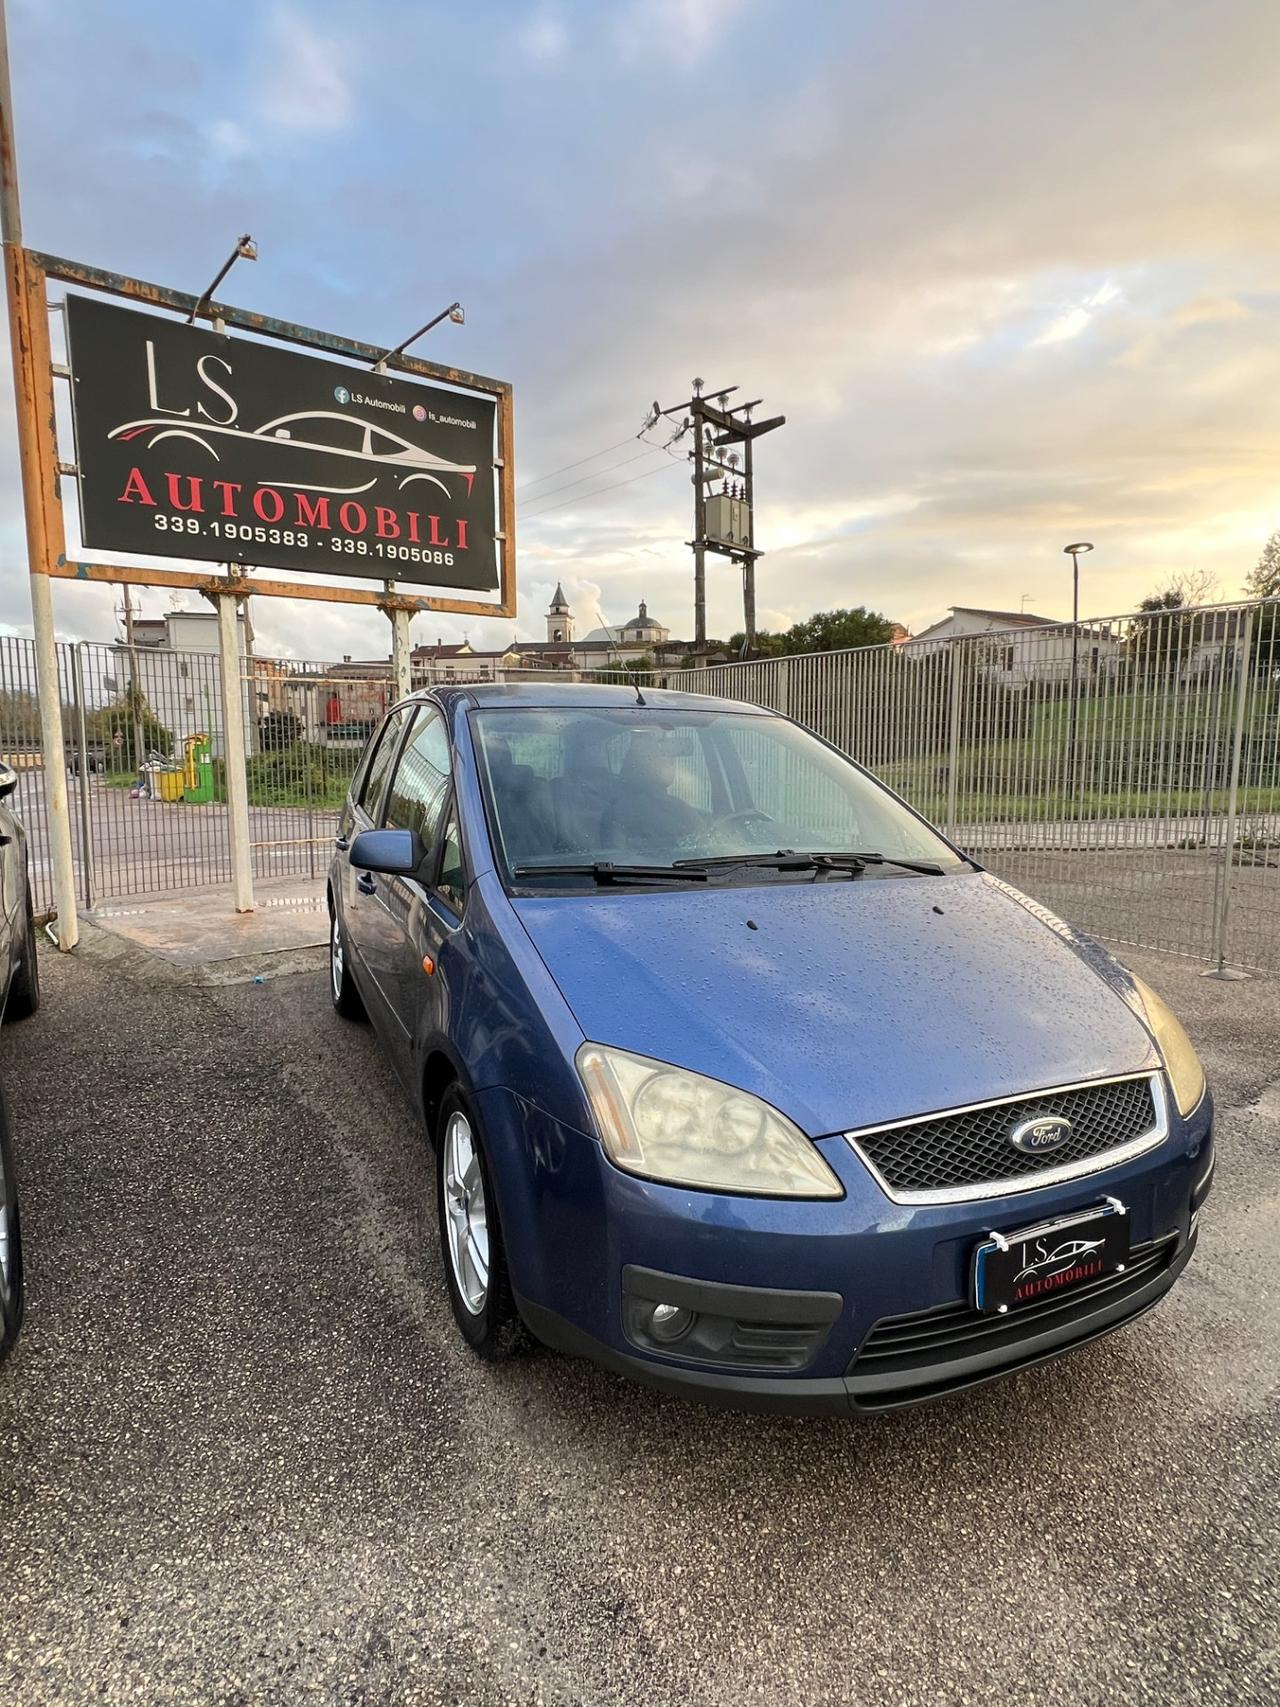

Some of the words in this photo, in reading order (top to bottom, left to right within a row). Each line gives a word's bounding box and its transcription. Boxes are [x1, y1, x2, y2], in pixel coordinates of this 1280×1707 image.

[351, 393, 364, 404] LS
[364, 396, 406, 414] Automobili
[117, 467, 469, 550] AUTOMOBILI
[154, 514, 309, 548] 339.1905383
[331, 537, 455, 567] 339.1905086
[1031, 1126, 1062, 1147] Ford
[1015, 1259, 1105, 1299] AUTOMOBILI
